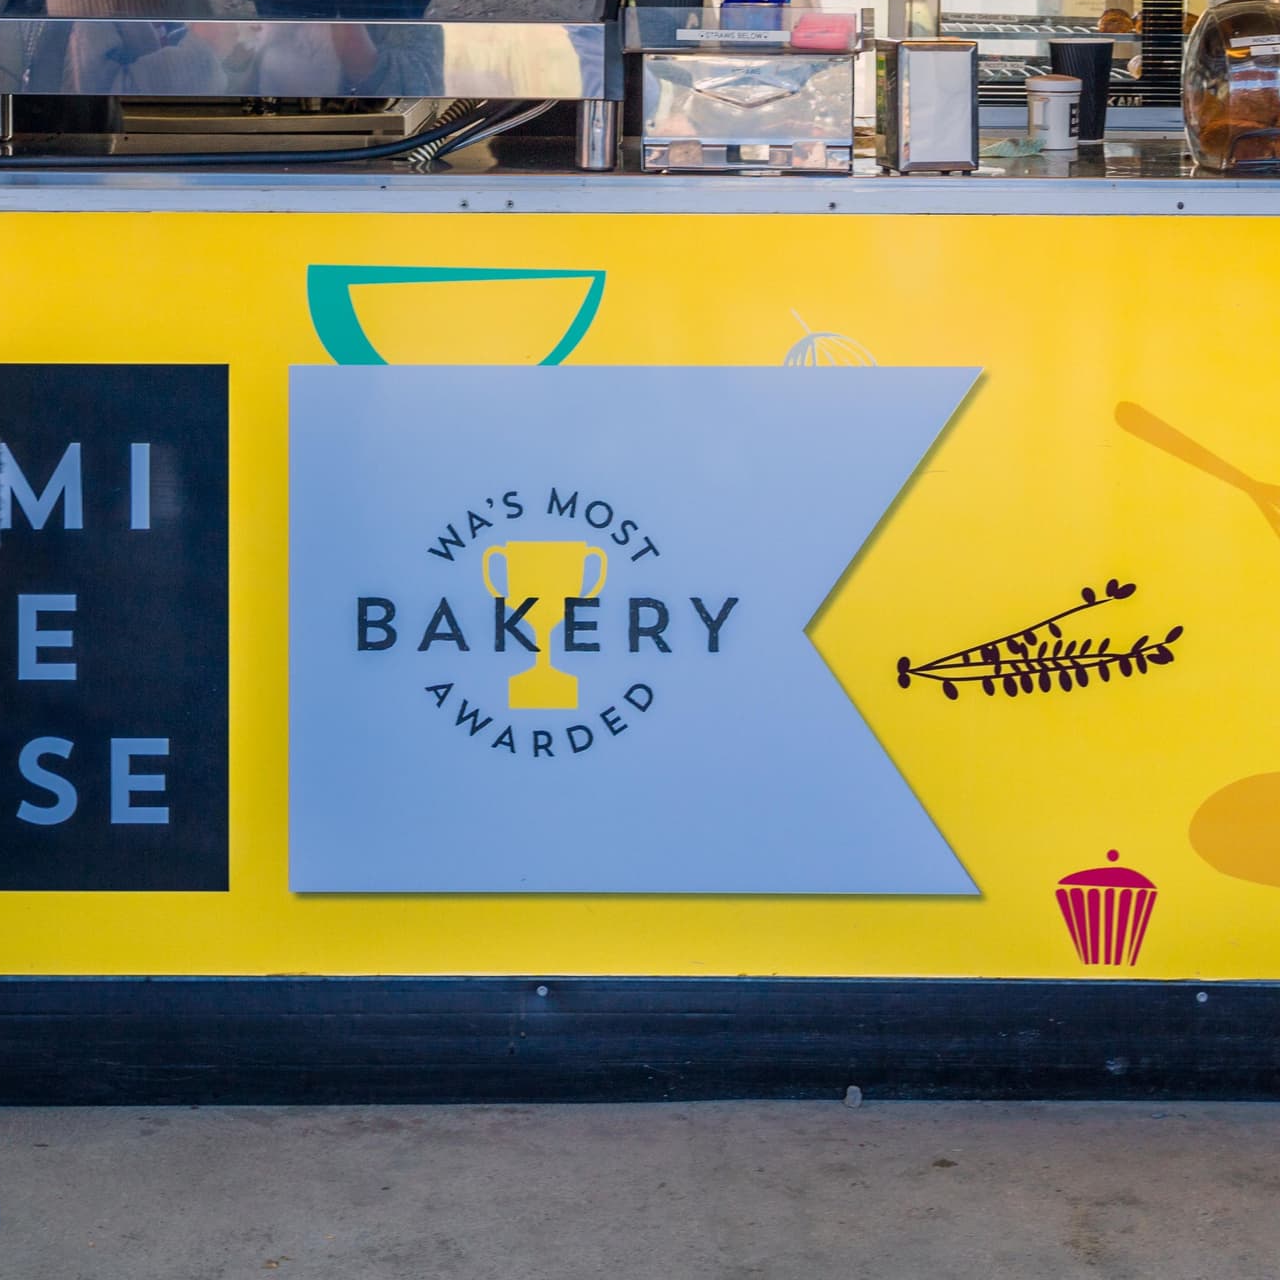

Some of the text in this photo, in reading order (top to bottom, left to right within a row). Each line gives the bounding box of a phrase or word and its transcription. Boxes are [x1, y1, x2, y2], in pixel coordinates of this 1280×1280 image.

[704, 31, 762, 40] STRAWS BELOW
[546, 486, 661, 563] MOST
[357, 596, 740, 654] BAKERY
[425, 682, 655, 758] AWARDED
